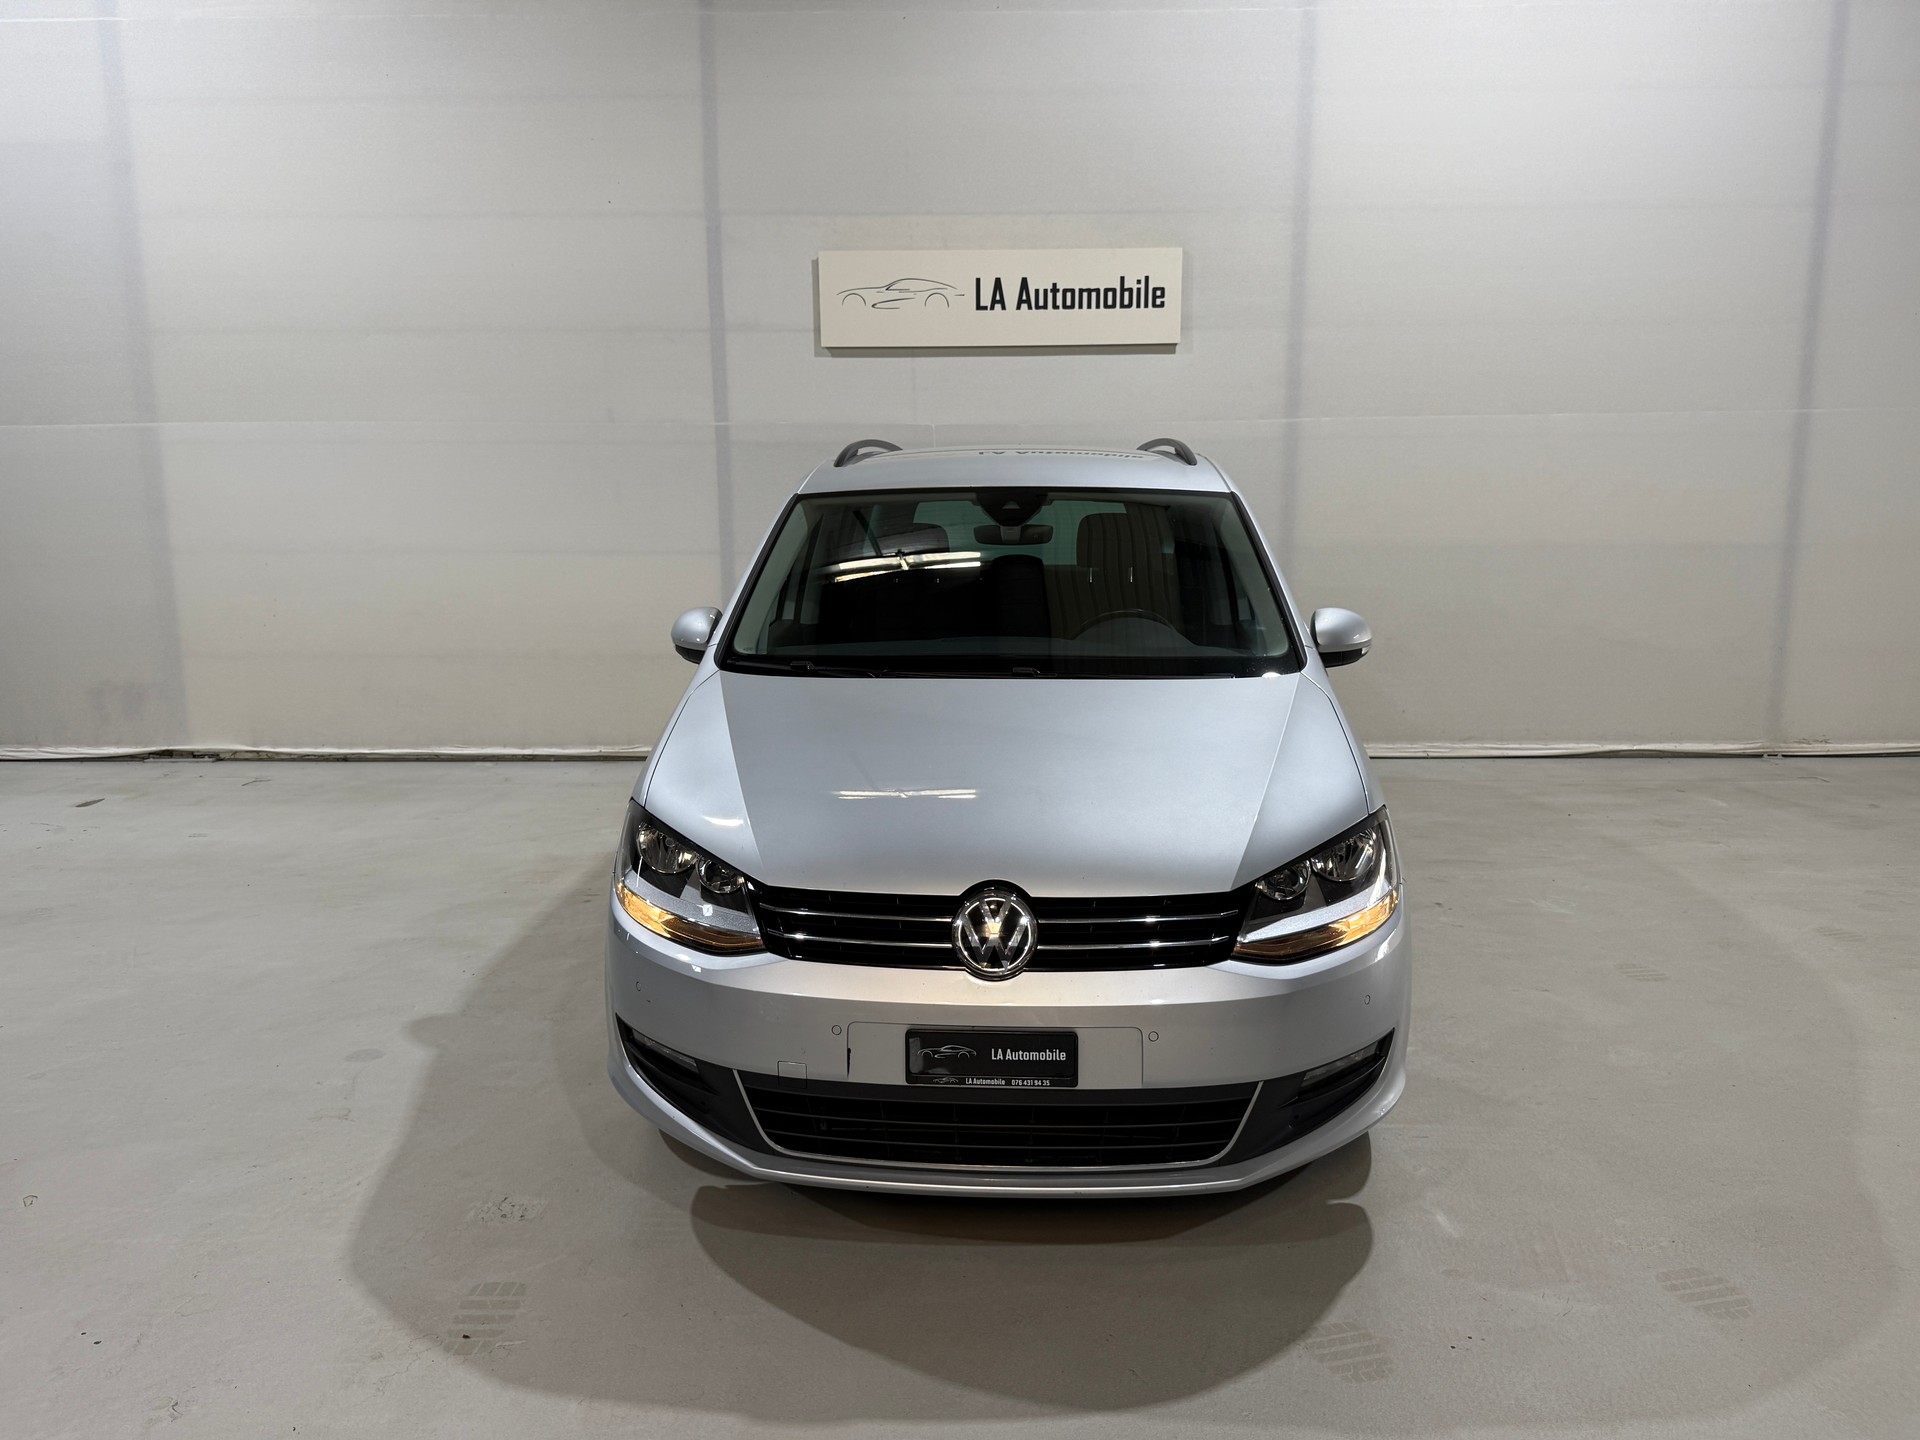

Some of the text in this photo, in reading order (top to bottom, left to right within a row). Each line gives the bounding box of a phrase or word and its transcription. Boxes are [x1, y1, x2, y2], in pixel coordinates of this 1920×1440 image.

[975, 275, 1166, 311] LA Automobile
[991, 1048, 1067, 1061] LA Automobile
[965, 1077, 973, 1085] LA
[973, 1077, 1006, 1086] Automobile
[1042, 1079, 1051, 1087] 35
